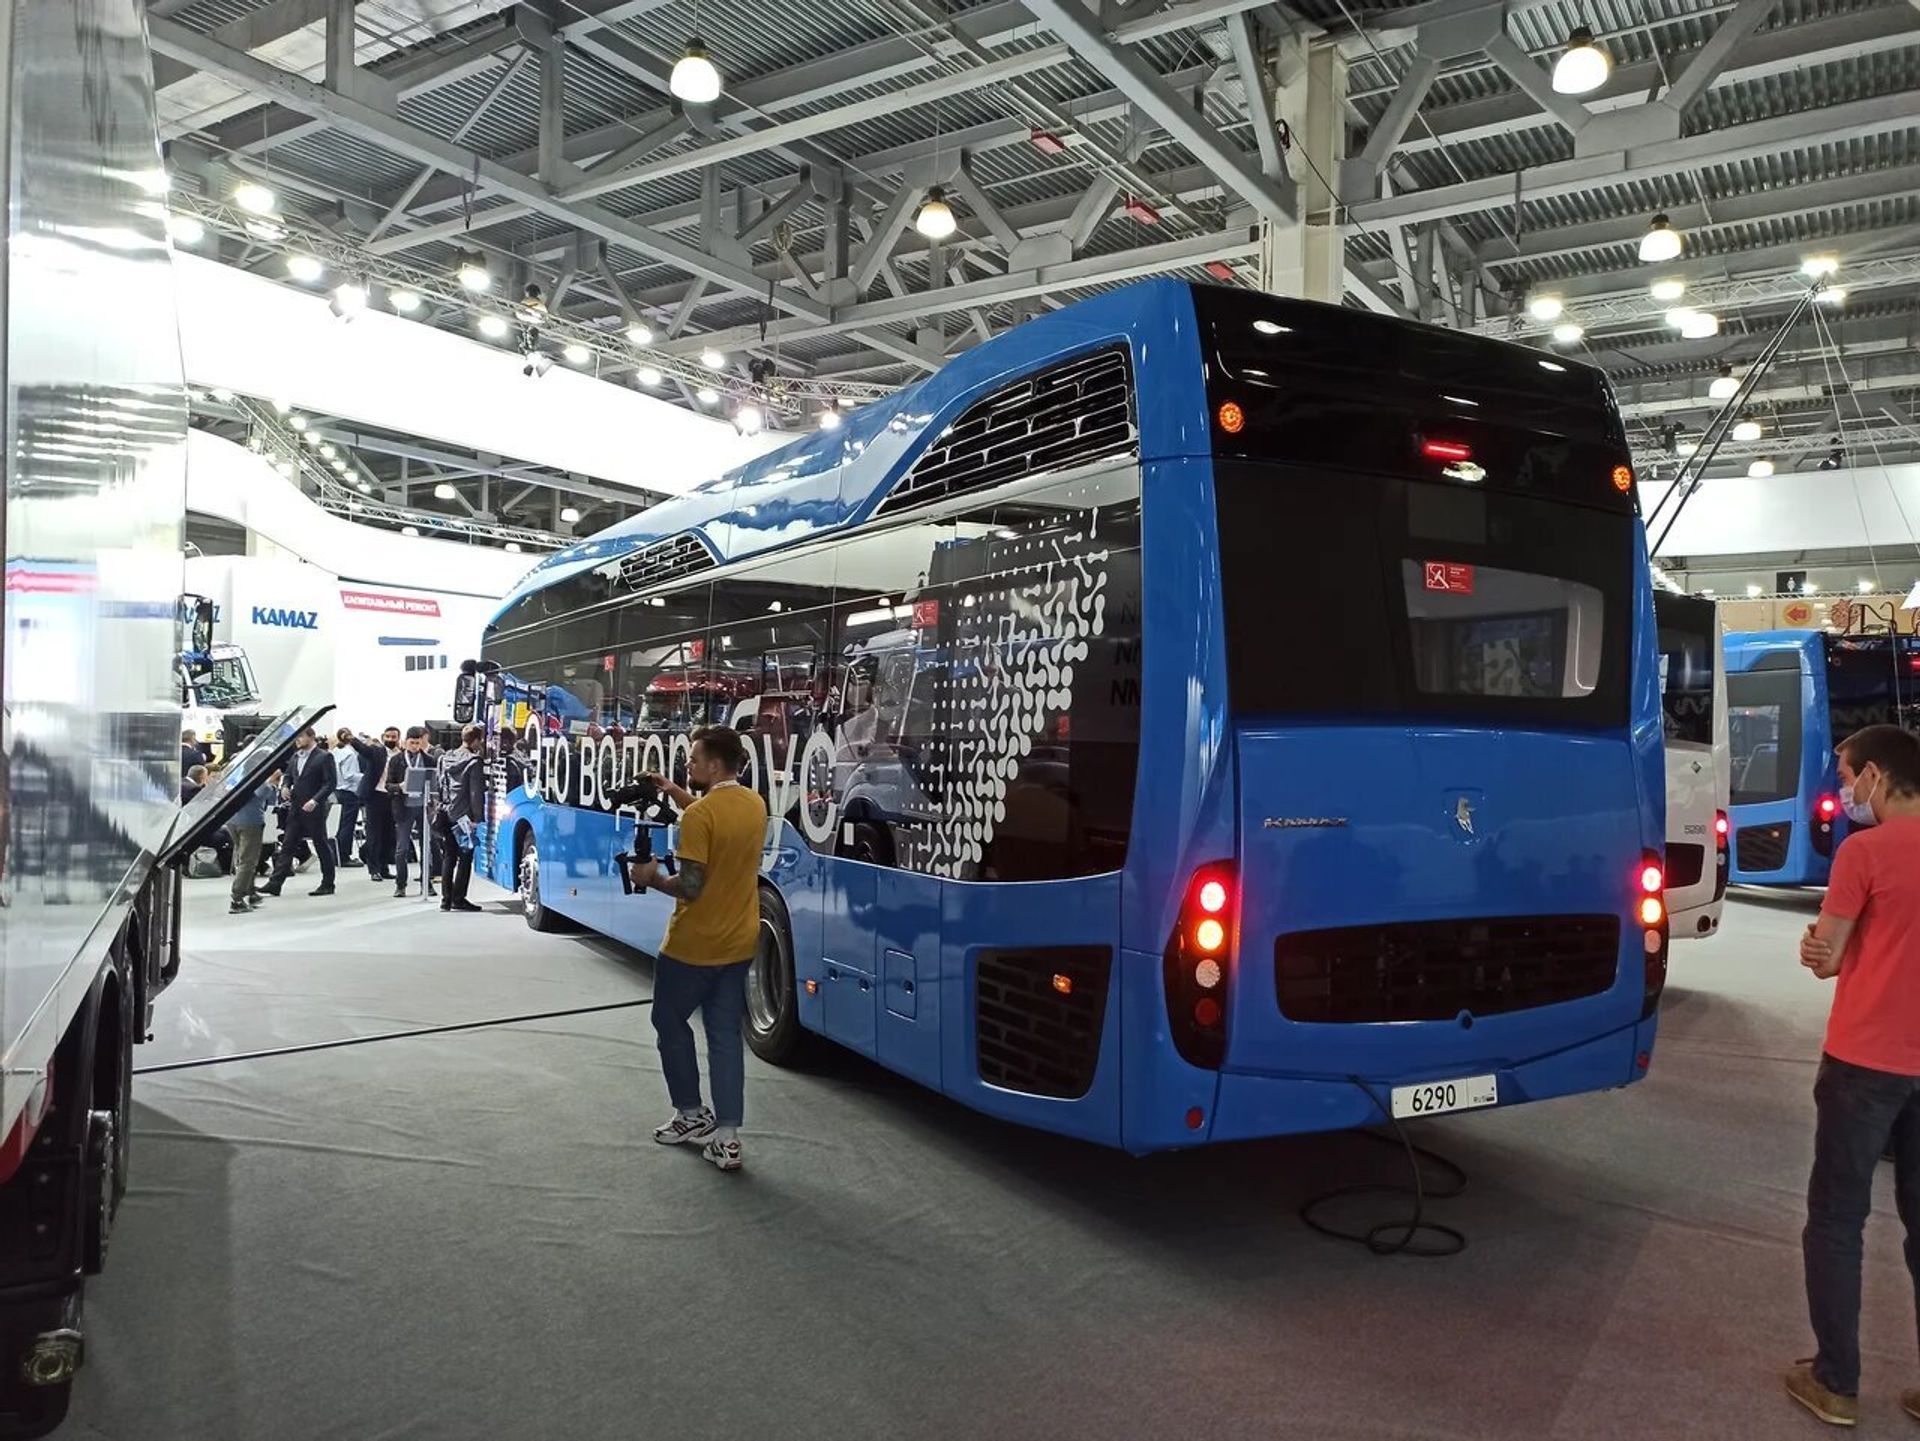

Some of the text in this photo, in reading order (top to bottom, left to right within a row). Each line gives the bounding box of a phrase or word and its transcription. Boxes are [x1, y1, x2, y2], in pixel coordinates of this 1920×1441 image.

[252, 606, 318, 629] KAMAZ
[523, 714, 570, 803] Это
[1412, 1084, 1456, 1112] 6290
